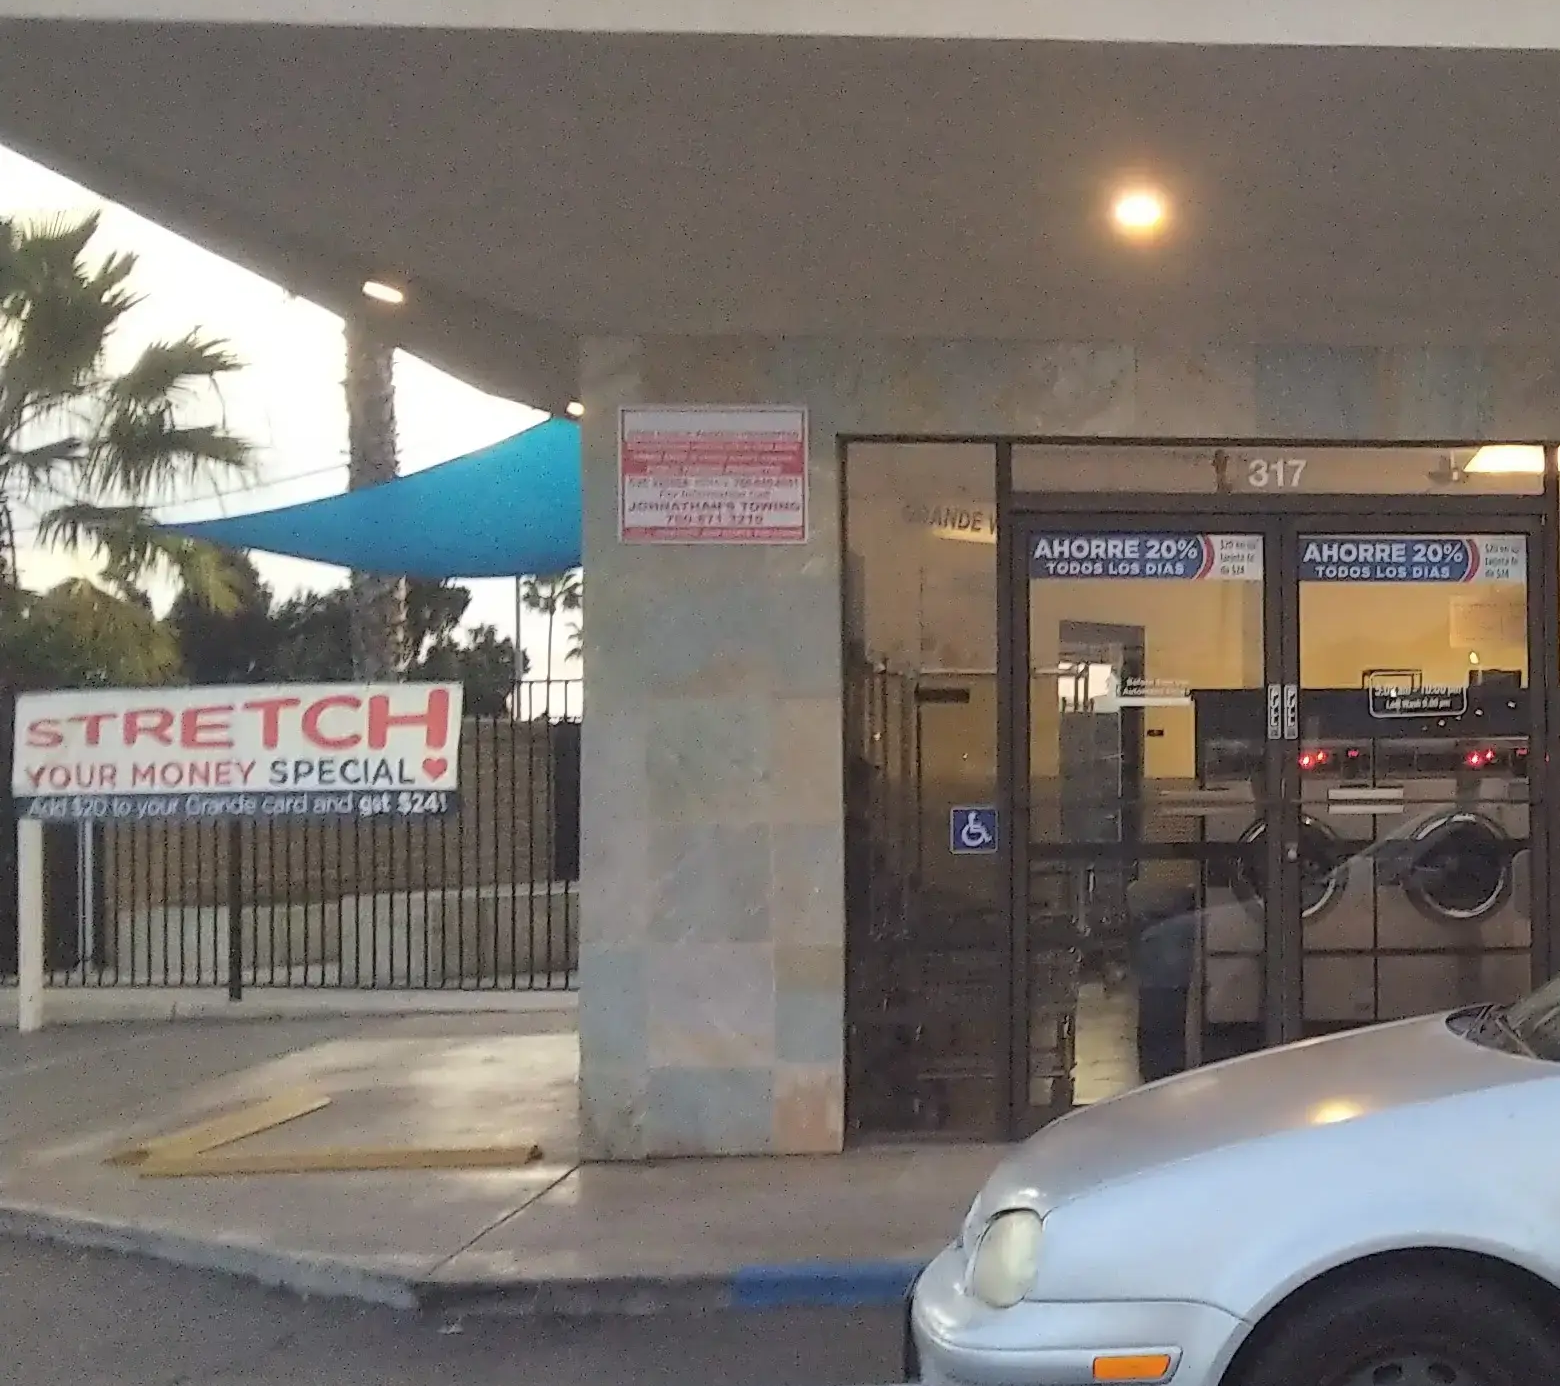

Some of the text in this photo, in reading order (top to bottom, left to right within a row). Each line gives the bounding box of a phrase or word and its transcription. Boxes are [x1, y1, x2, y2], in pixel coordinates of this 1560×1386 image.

[1248, 458, 1307, 487] 317
[1033, 536, 1198, 560] AHORRE 20%
[1302, 542, 1464, 563] AHORRE 20%
[1045, 562, 1104, 576] TODOS
[1108, 562, 1141, 576] LOS
[1314, 565, 1370, 580] TODOS
[1376, 565, 1408, 580] LOS
[26, 757, 416, 789] YOUR MONEY SPECIAL
[136, 797, 180, 821] your
[185, 794, 256, 817] Grande
[261, 792, 309, 815] card
[313, 791, 354, 814] and
[359, 792, 392, 817] get
